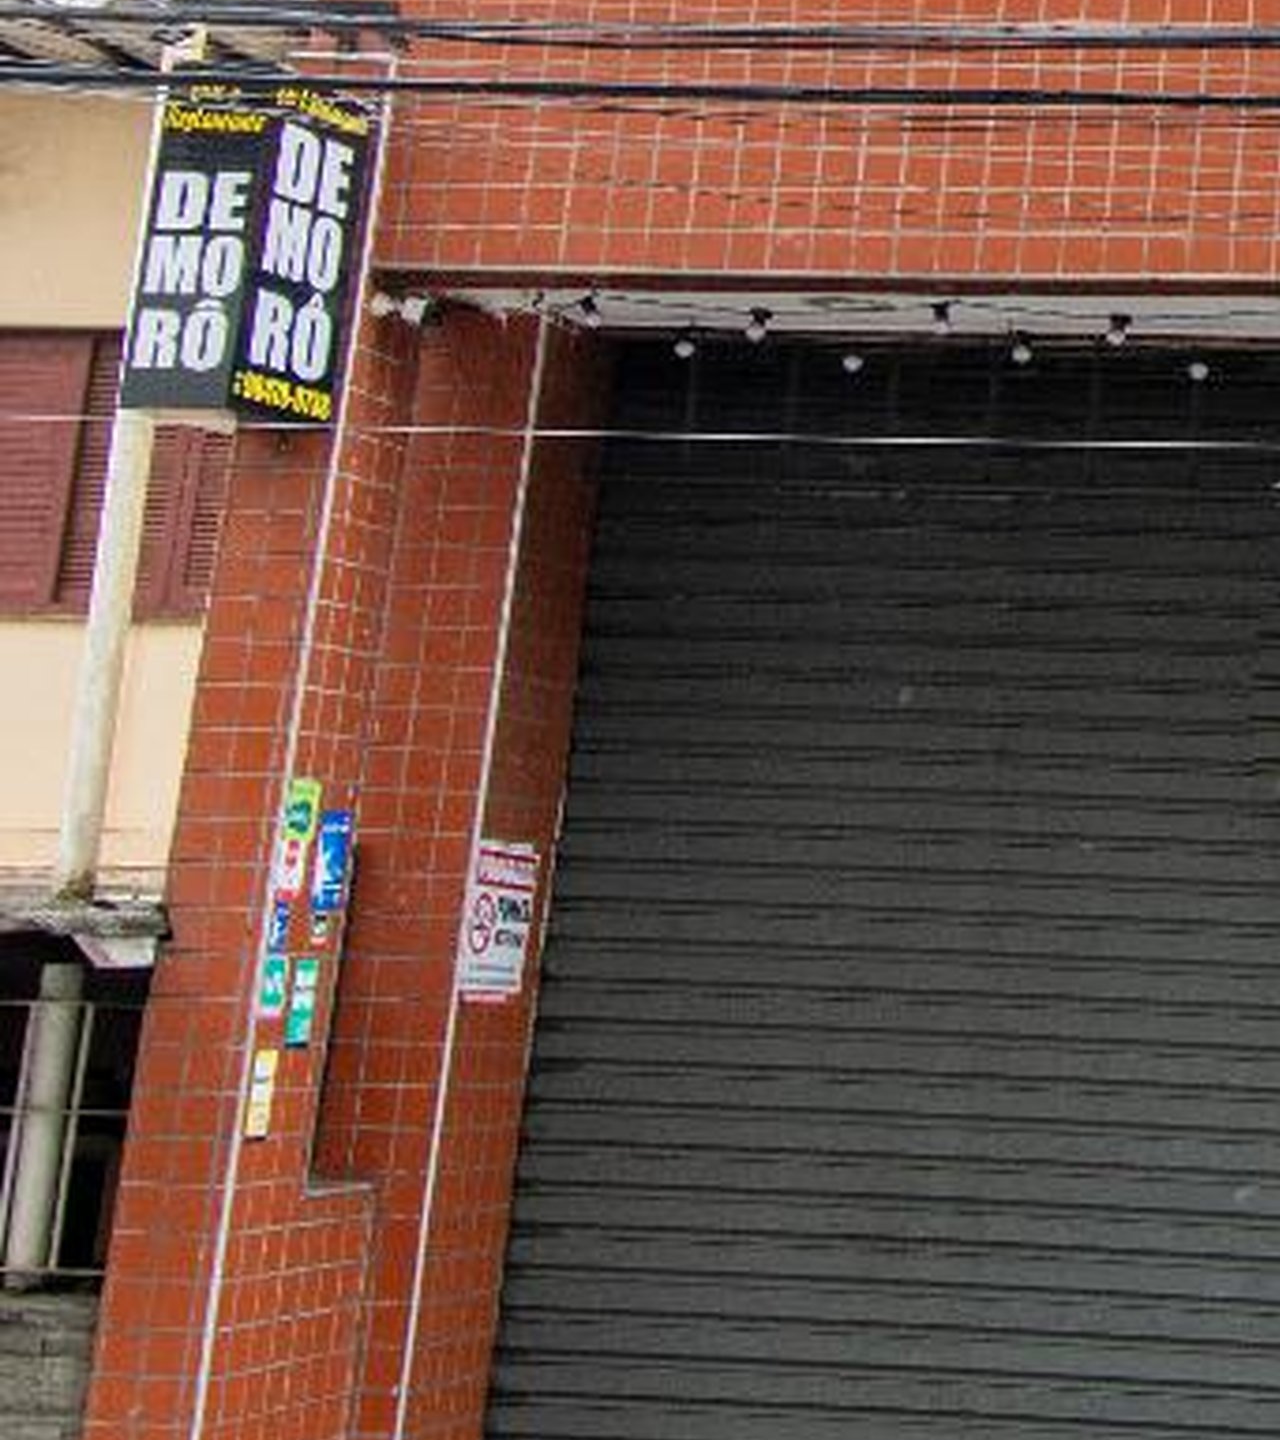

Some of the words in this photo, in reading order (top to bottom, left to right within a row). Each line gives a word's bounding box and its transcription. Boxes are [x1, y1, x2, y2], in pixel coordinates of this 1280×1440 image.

[155, 171, 254, 231] DE
[274, 122, 355, 218] DE
[143, 235, 245, 298] MO
[262, 198, 343, 293] MO
[131, 298, 229, 371] RÔ
[249, 288, 334, 381] RÔ
